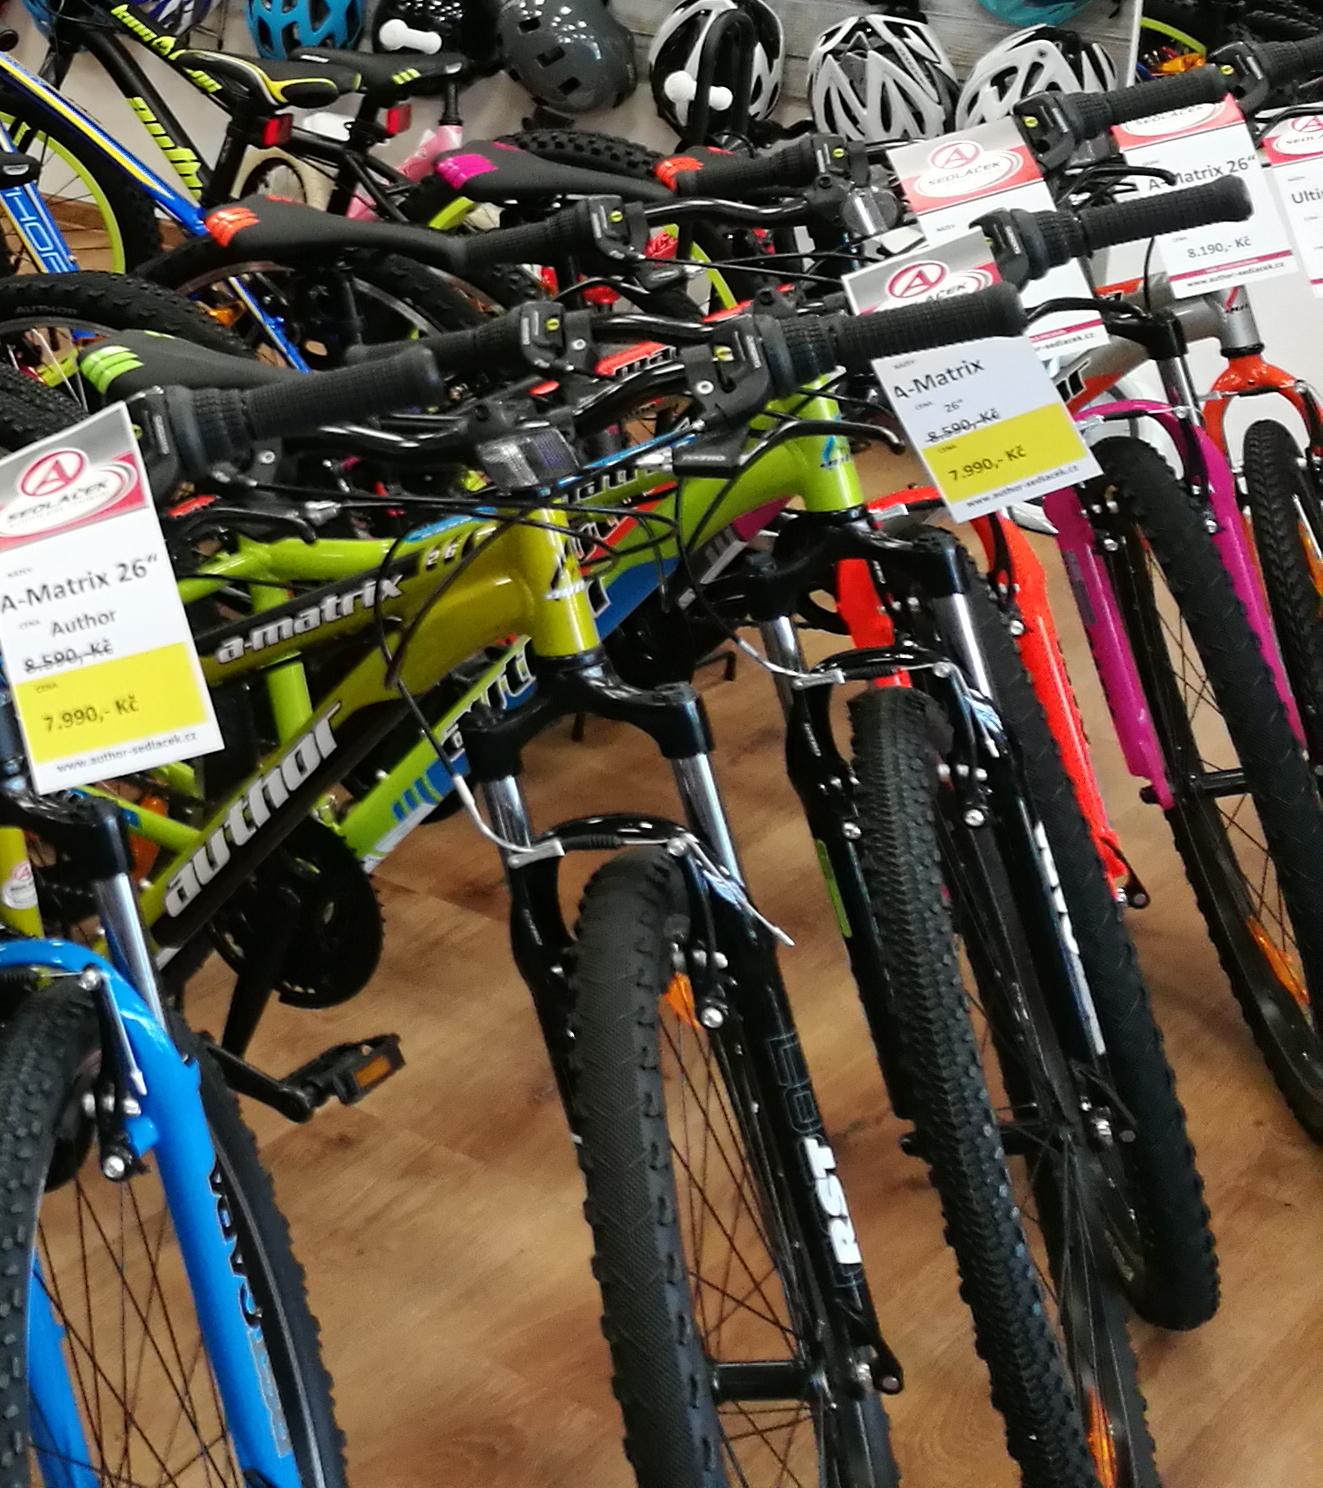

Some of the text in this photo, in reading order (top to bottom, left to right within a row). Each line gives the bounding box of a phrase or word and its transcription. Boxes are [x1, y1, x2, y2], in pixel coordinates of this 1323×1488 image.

[927, 159, 1001, 187] SEDLAČEK
[1291, 188, 1323, 205] Ulti
[1188, 236, 1252, 260] 8.190,- Kč
[893, 359, 985, 401] A-Matrix
[927, 408, 1001, 444] 8.590,- Kč
[948, 444, 1027, 482] 7.990,- Kč
[7, 478, 110, 523] SEDLAČEK
[0, 570, 111, 614] A-Matrix
[51, 610, 118, 638] Author
[216, 574, 403, 667] a-matrix
[42, 694, 140, 734] 7.990,- Kč
[55, 731, 198, 774] www.author-sedlacek.cz
[164, 700, 343, 918] author
[803, 1135, 863, 1266] RST
